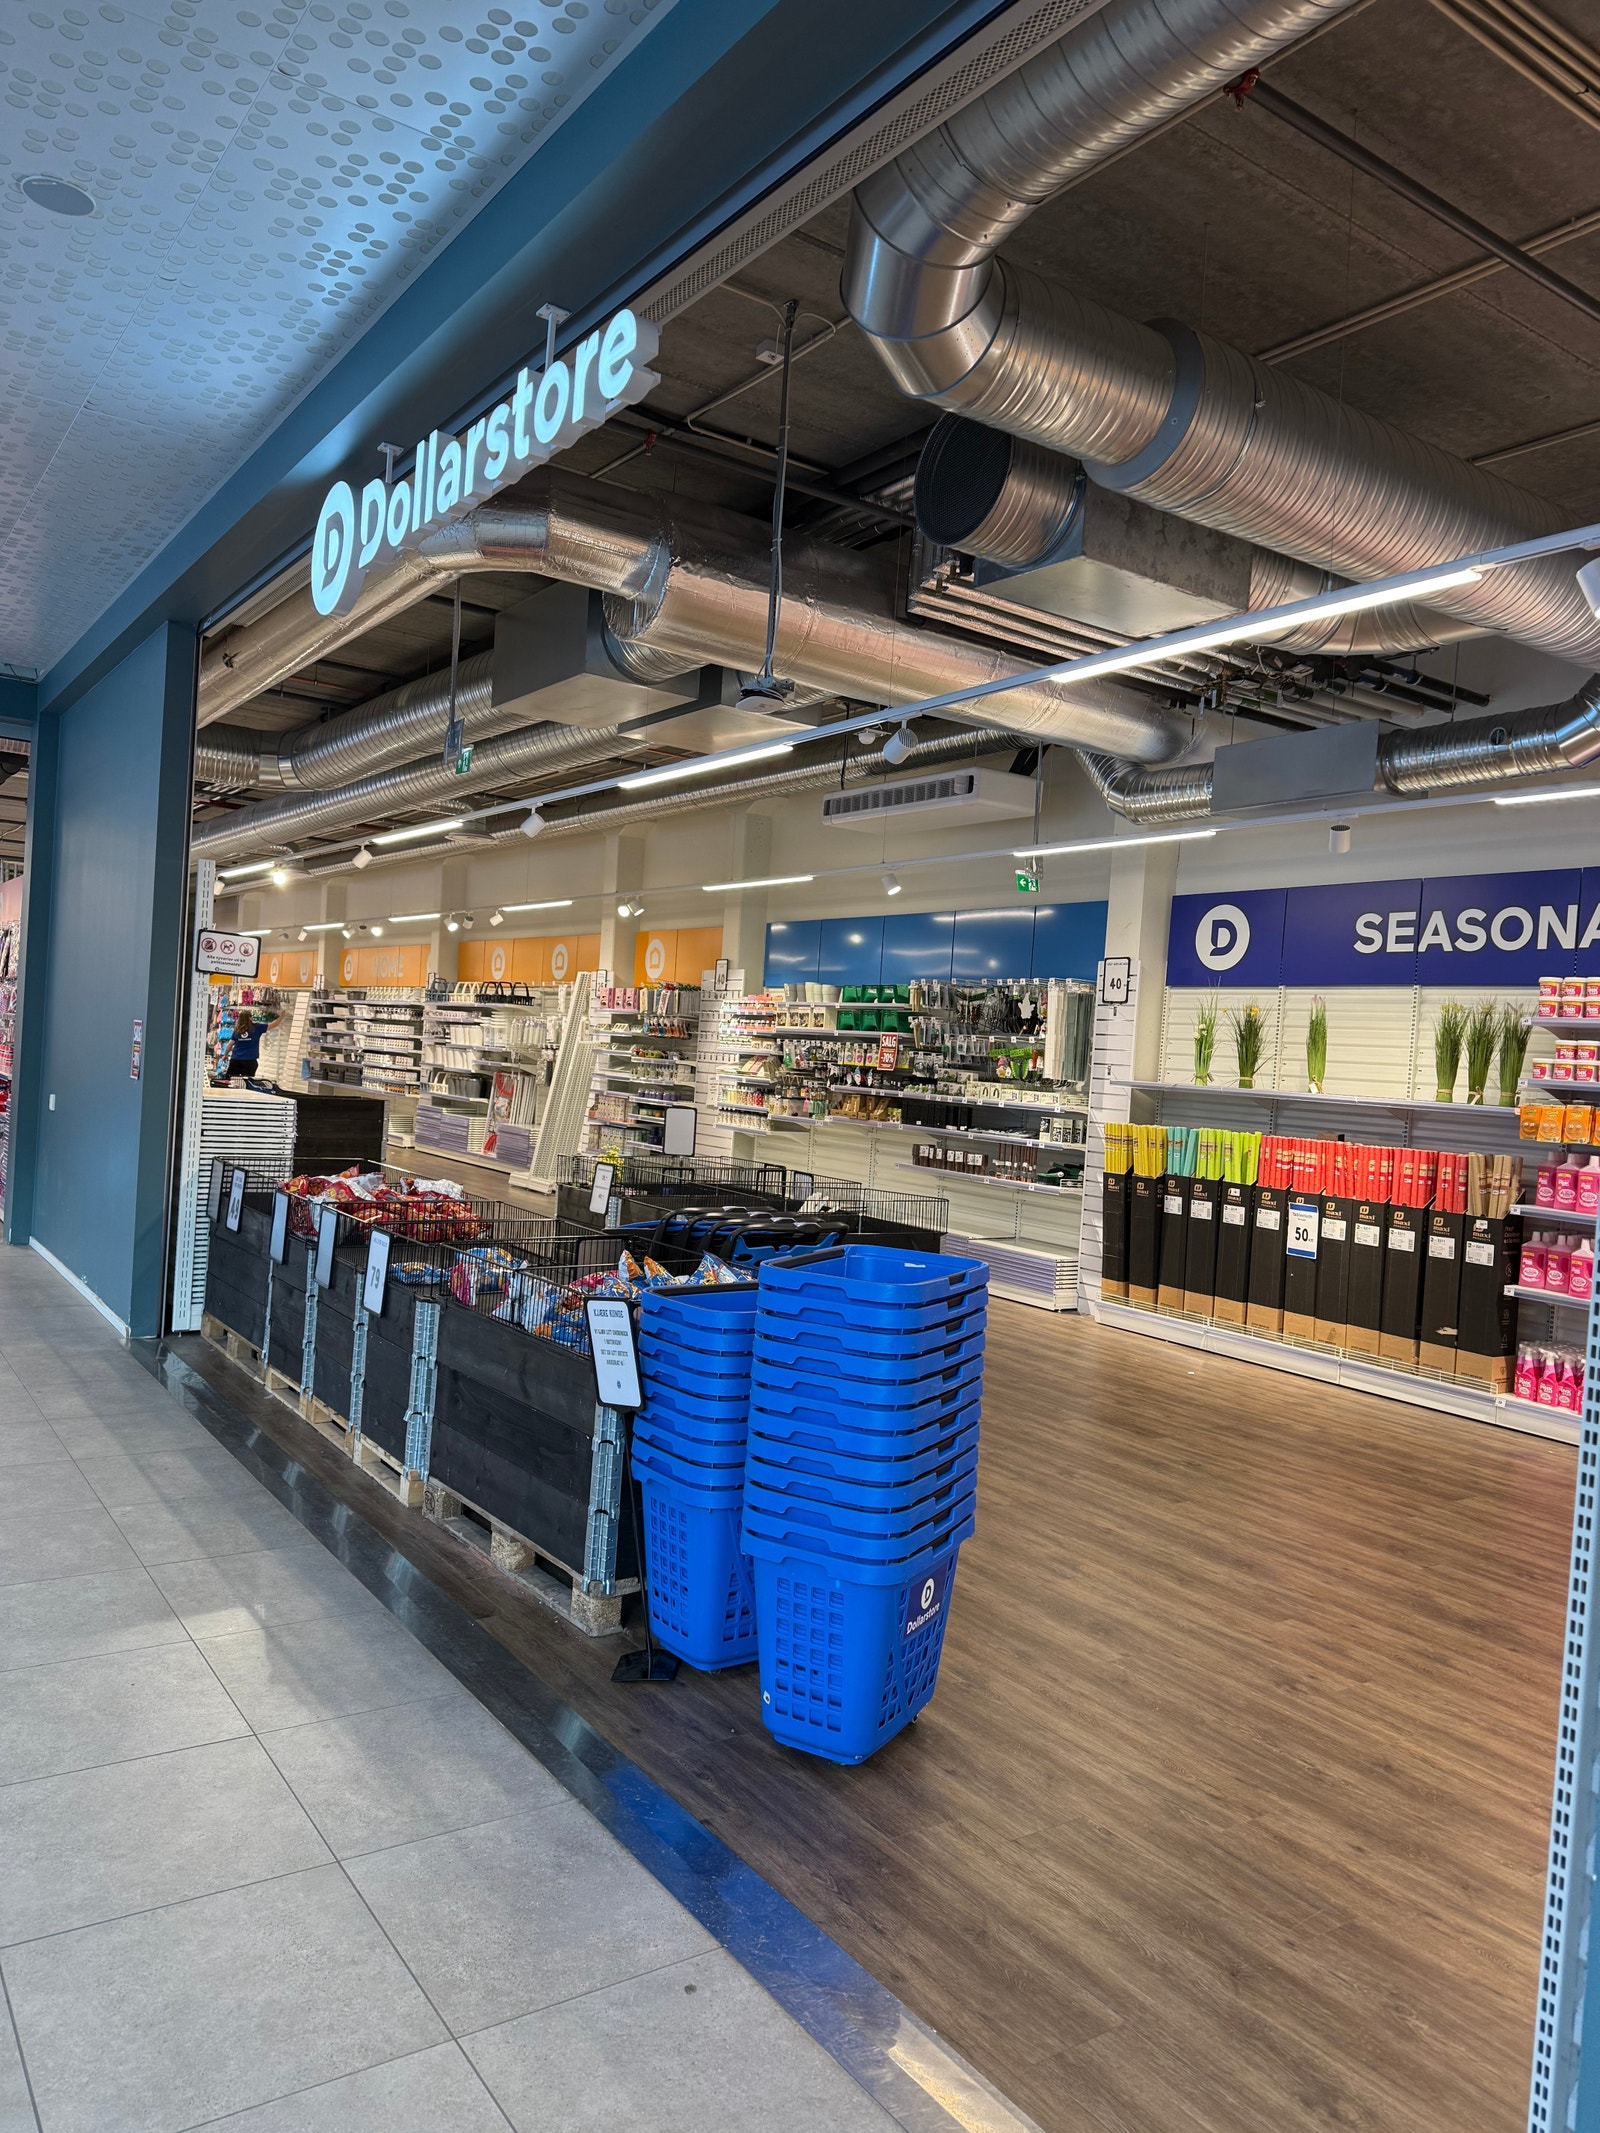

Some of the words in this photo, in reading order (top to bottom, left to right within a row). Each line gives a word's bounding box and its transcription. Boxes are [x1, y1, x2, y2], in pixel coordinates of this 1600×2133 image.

[358, 308, 637, 570] Dollarstore
[372, 954, 404, 978] HOME
[1109, 977, 1122, 990] 40
[882, 1036, 896, 1047] SALG
[1294, 1226, 1309, 1242] 50
[371, 1265, 381, 1289] 79
[906, 1602, 940, 1635] Dollarstore
